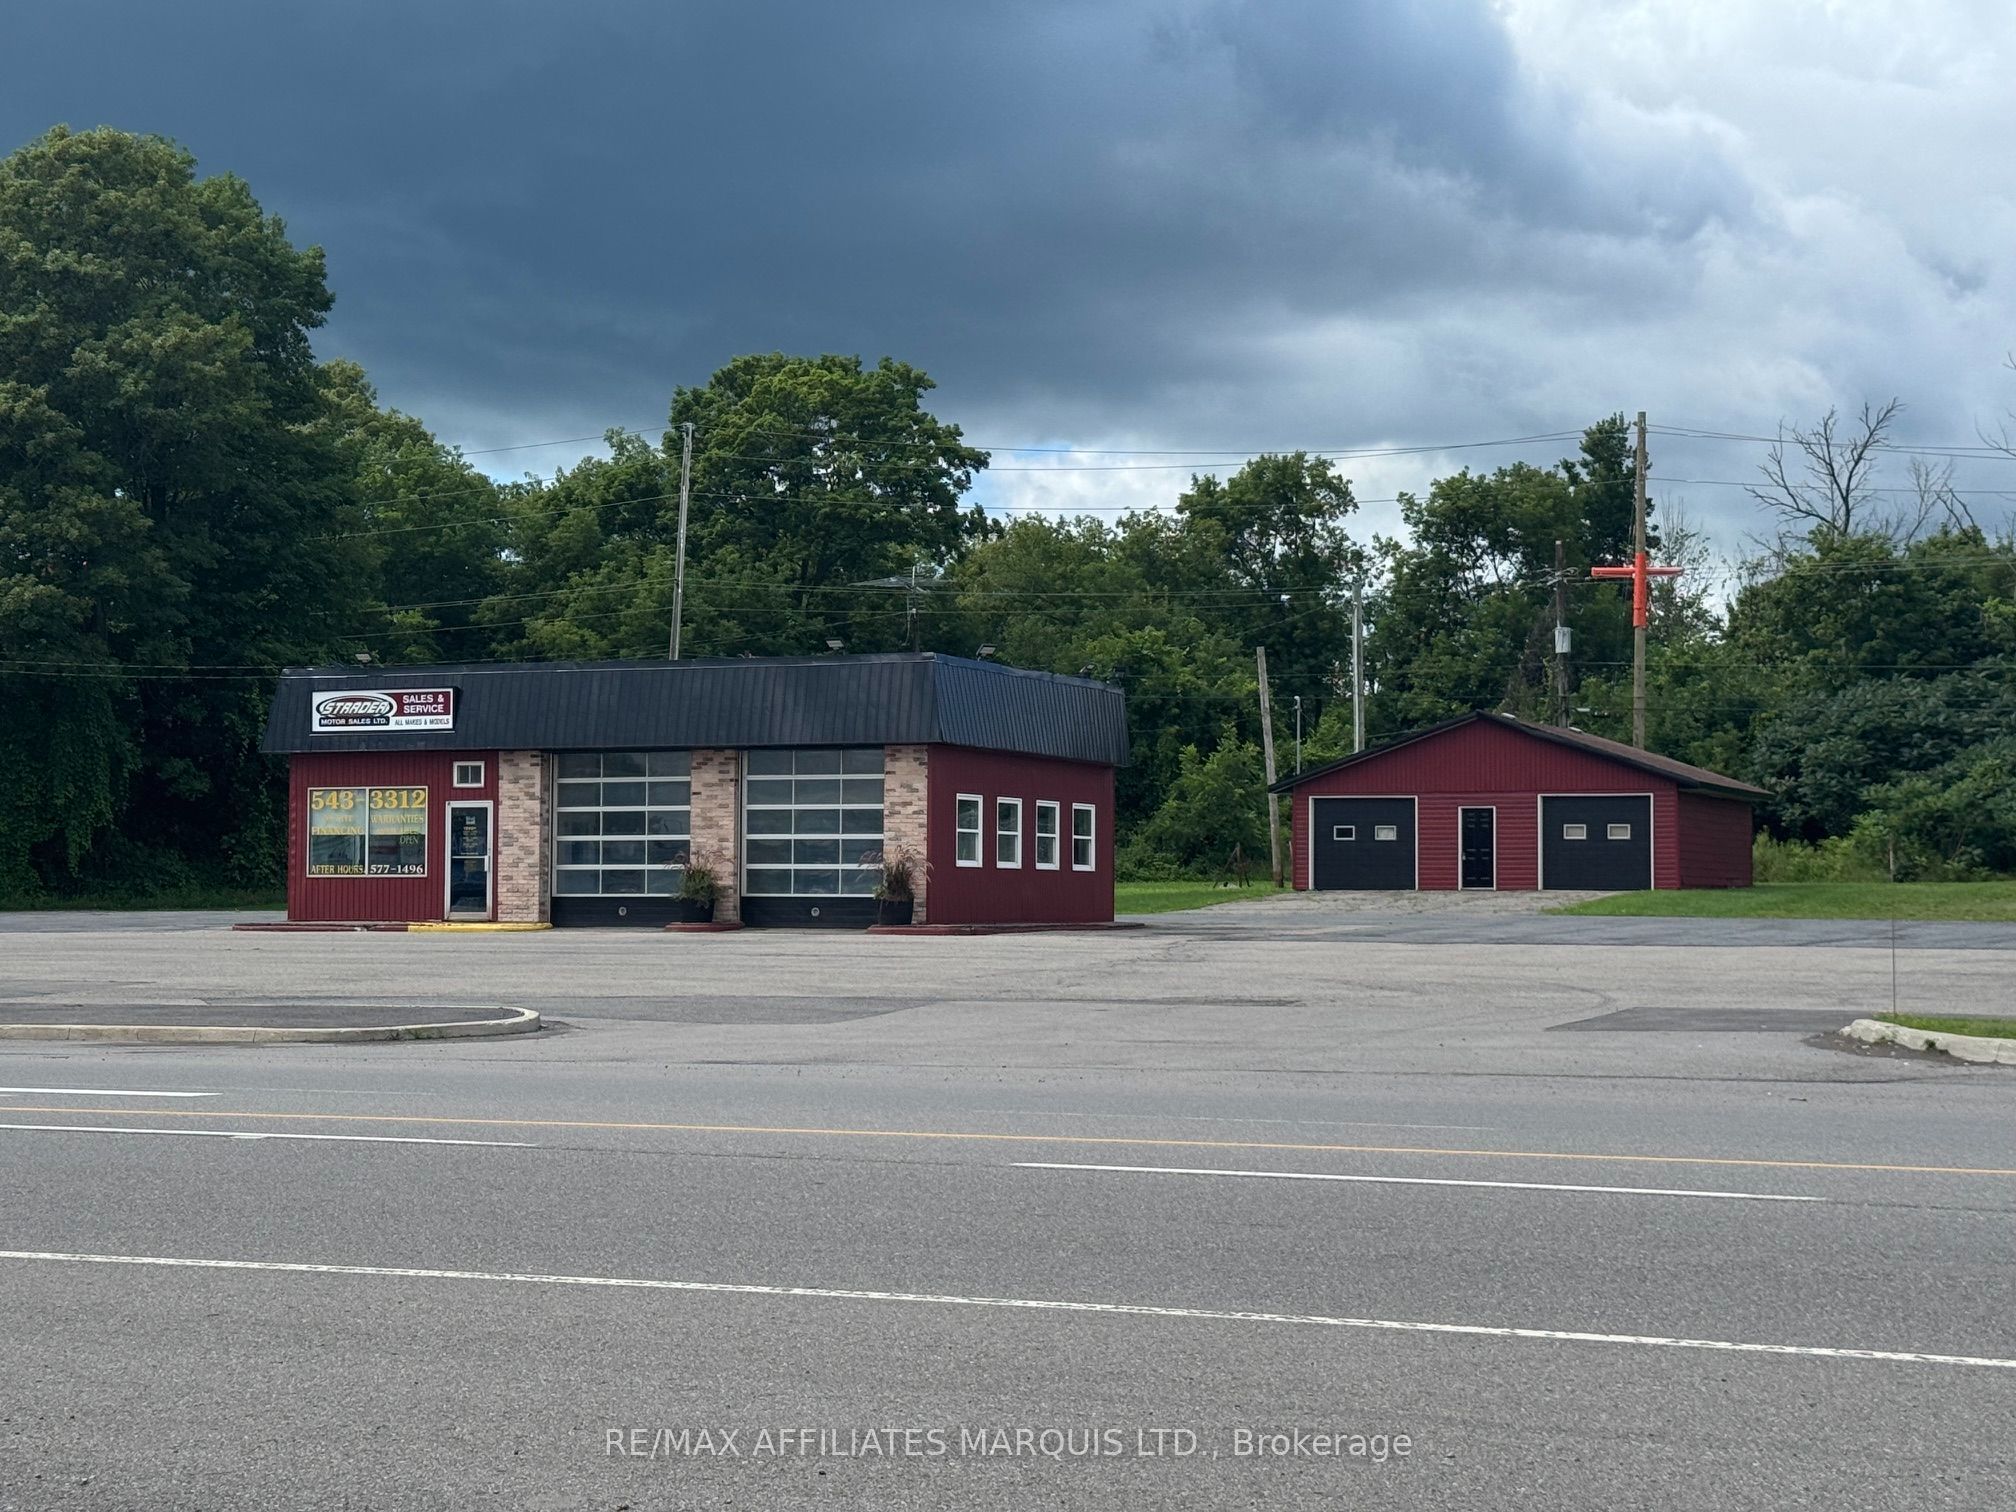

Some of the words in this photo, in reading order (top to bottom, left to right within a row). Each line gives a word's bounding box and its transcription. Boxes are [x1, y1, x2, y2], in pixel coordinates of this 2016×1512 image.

[402, 694, 434, 704] SALES
[437, 694, 445, 703] &
[403, 704, 445, 714] SERVICE
[310, 864, 335, 874] AFTER
[370, 864, 424, 874] 577-1496
